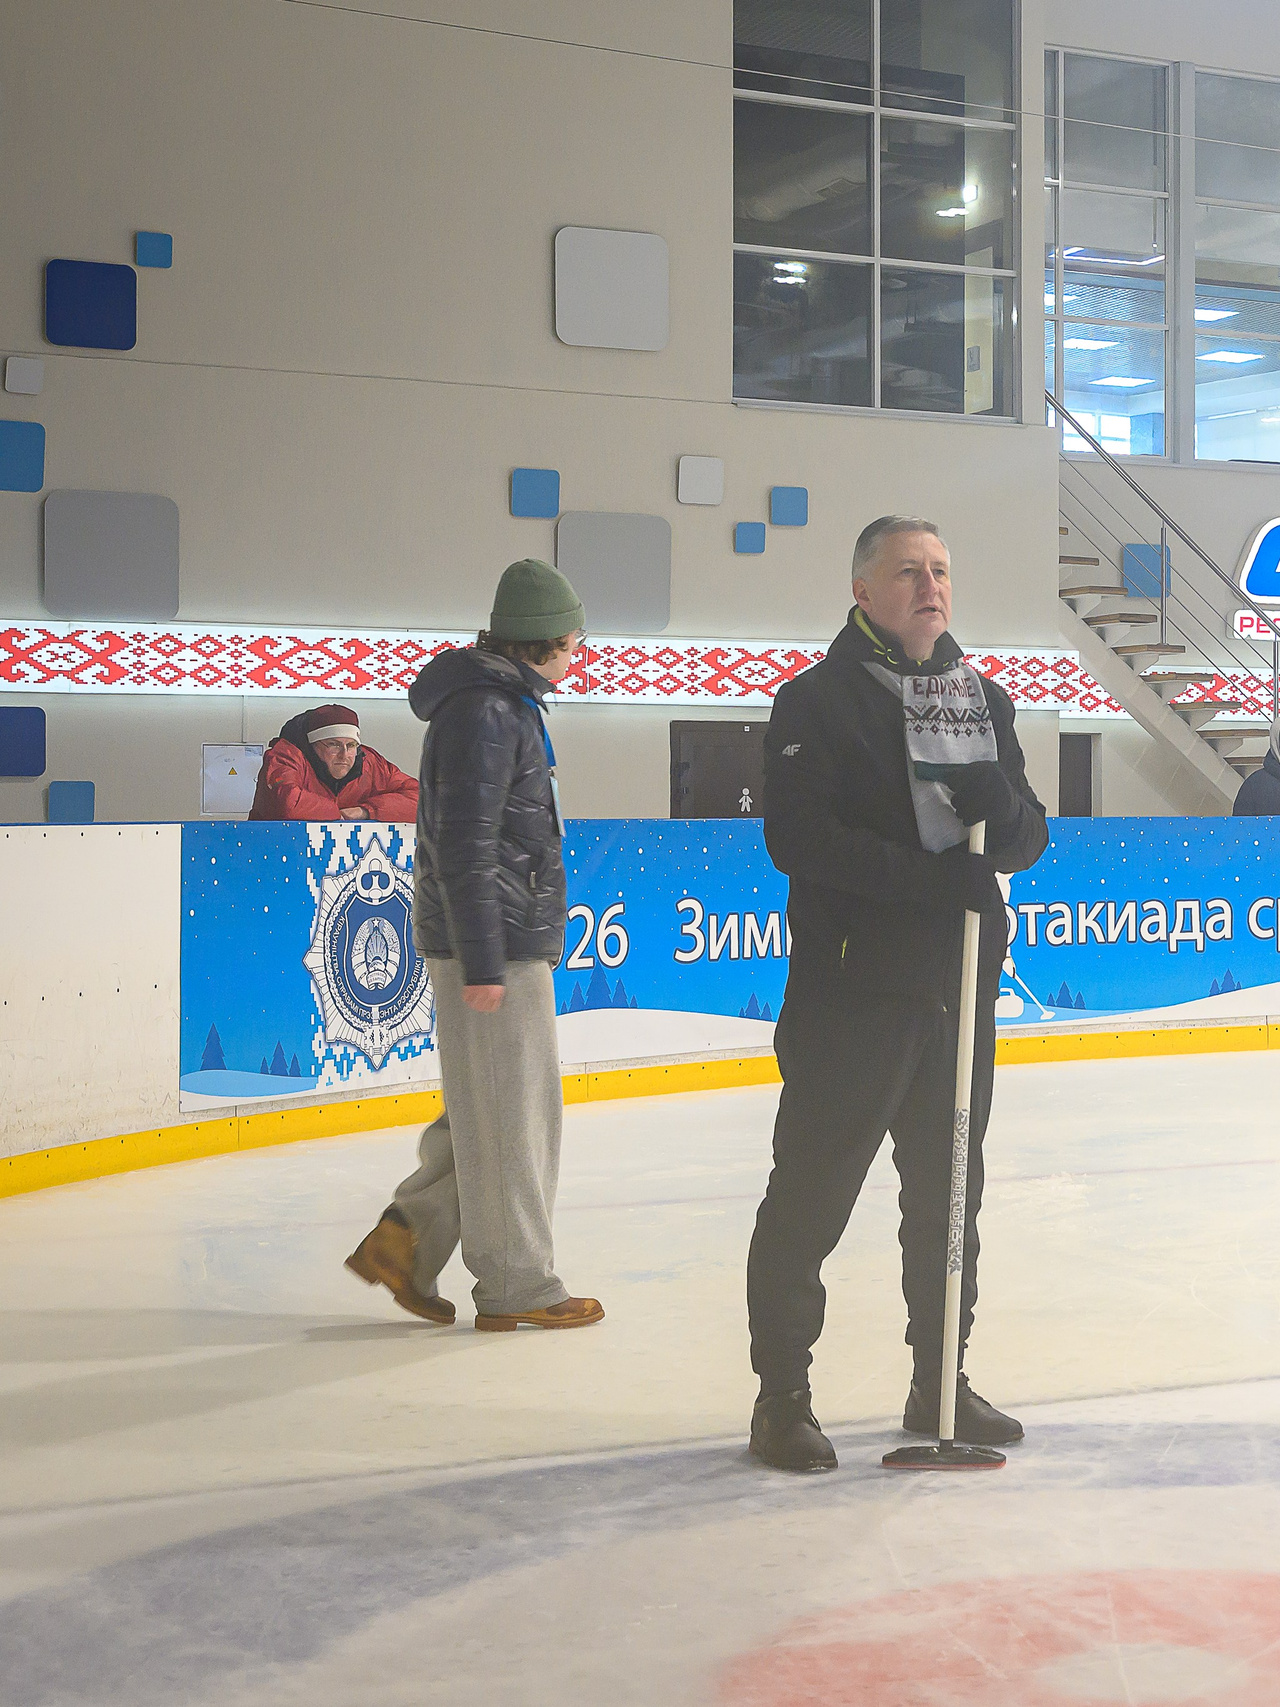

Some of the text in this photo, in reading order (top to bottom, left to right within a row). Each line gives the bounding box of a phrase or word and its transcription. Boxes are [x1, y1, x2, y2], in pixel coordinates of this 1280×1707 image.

[782, 743, 802, 757] 4F
[552, 902, 630, 970] 26
[672, 896, 793, 963] Зим
[1004, 896, 1233, 953] такиада
